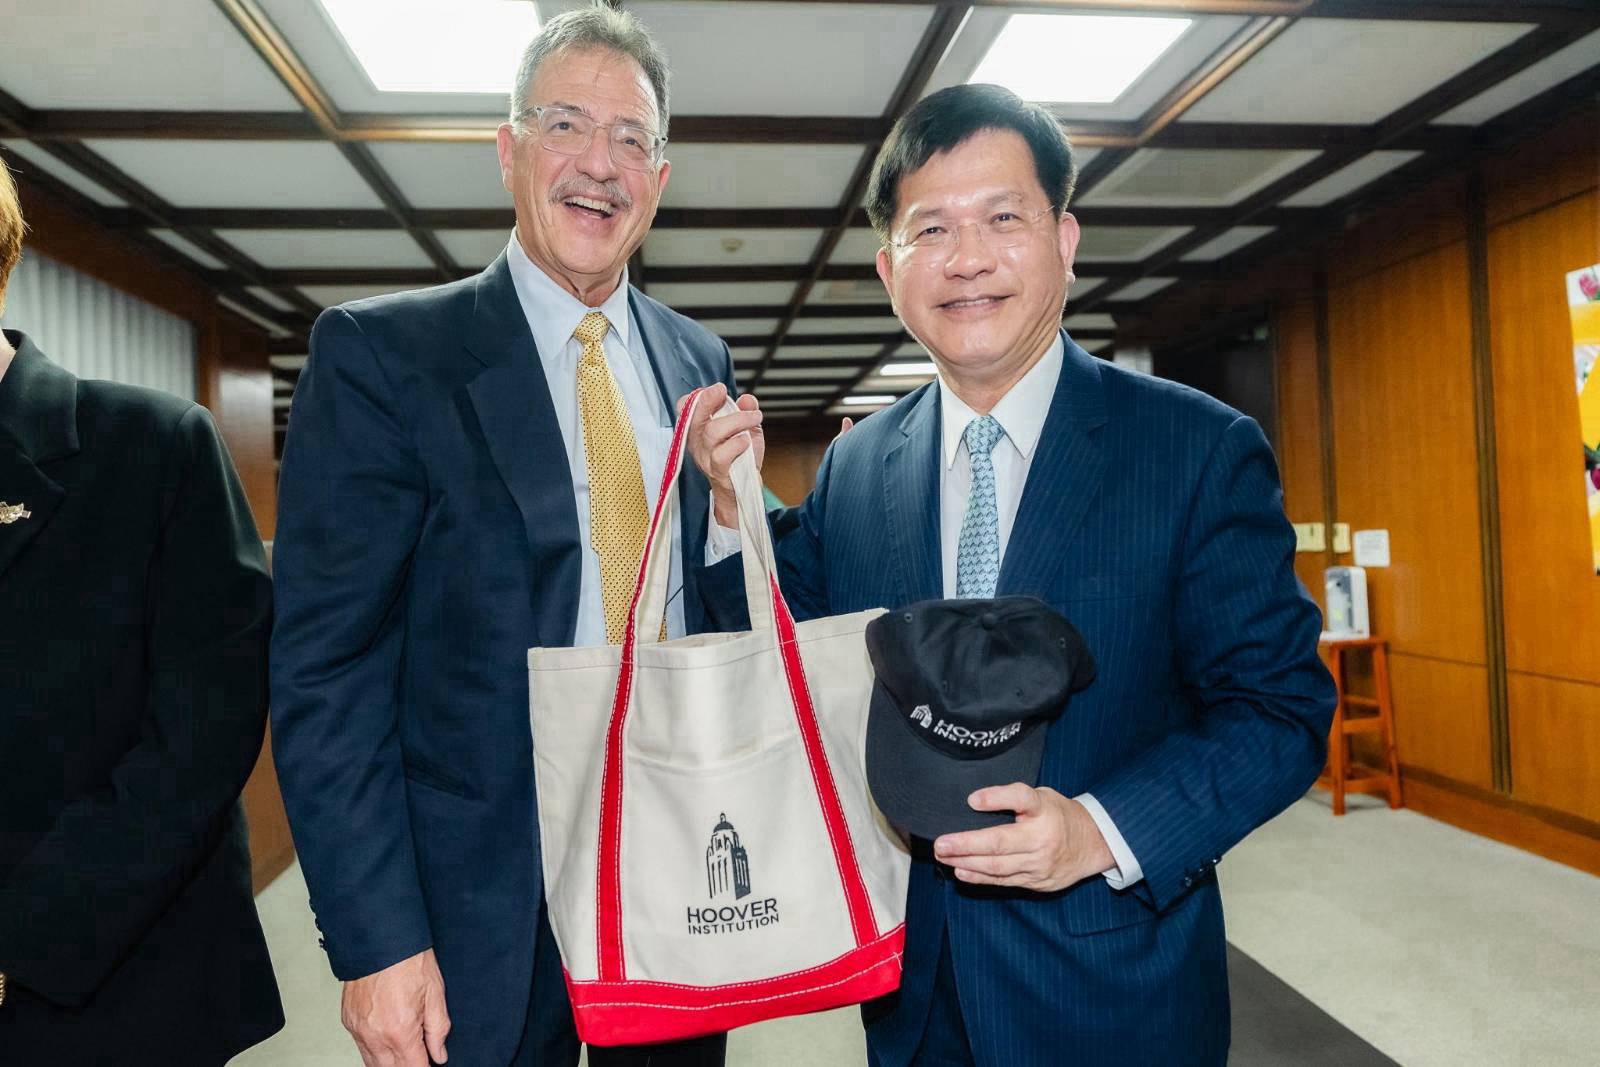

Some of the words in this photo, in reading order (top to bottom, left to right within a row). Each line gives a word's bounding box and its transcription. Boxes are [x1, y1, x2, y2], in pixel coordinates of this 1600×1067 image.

[933, 726, 1020, 747] INSTITUTION
[937, 719, 1021, 740] HOOVER
[687, 898, 778, 923] HOOVER
[688, 913, 779, 935] INSTITUTION
